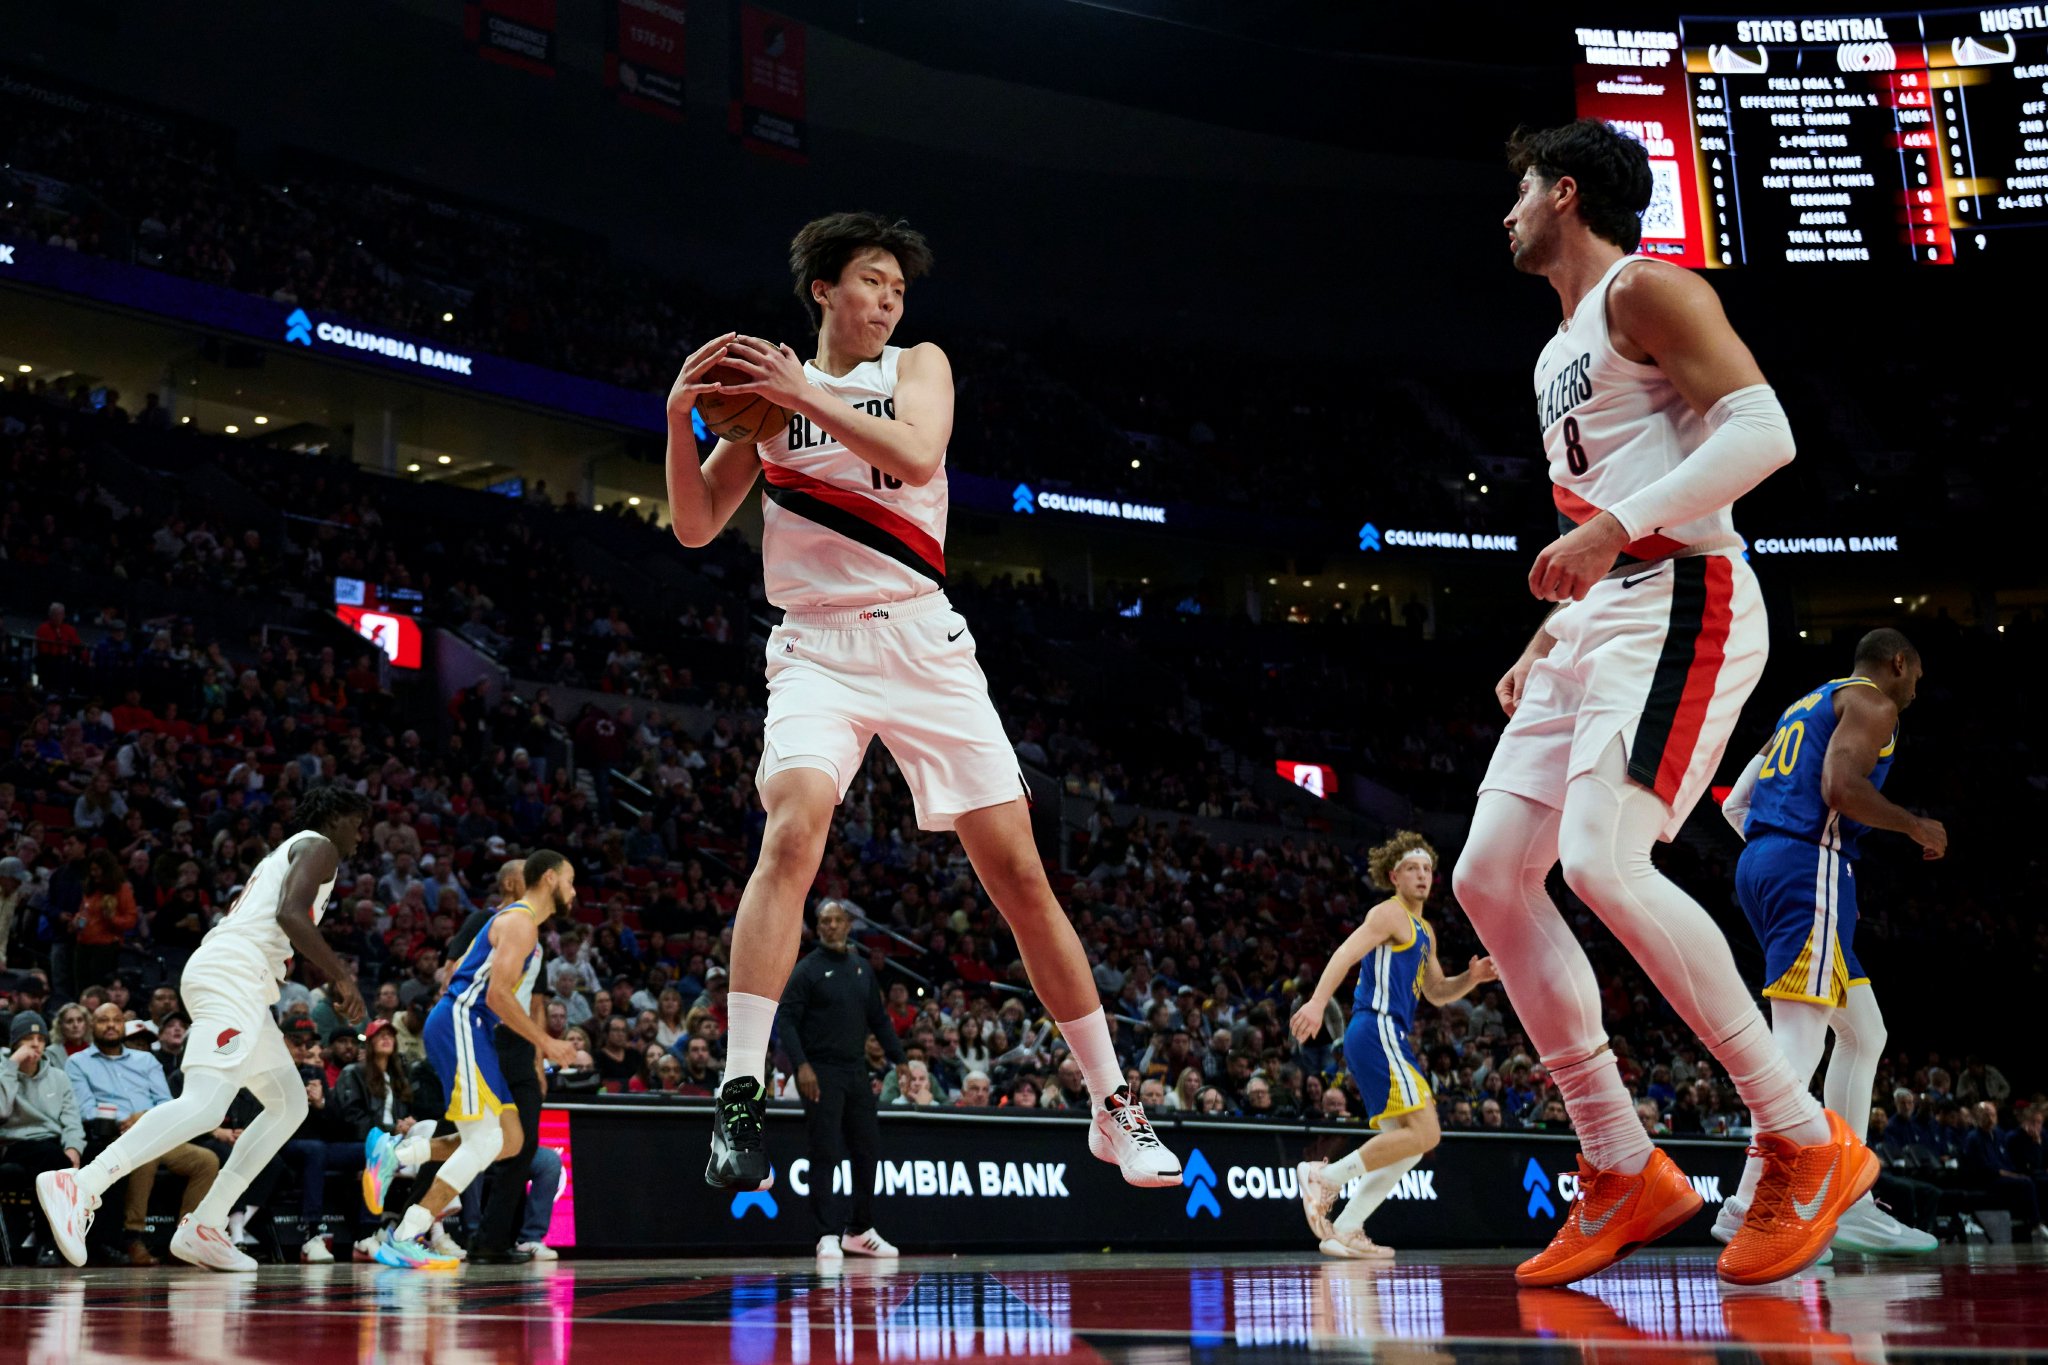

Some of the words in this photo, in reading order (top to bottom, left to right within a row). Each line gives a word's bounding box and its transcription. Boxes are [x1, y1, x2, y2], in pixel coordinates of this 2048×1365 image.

[1737, 20, 1797, 42] STATS
[1801, 18, 1888, 41] CENTRAL
[1575, 28, 1617, 47] TRAIL
[1617, 30, 1678, 49] BLAZERS
[1642, 49, 1670, 67] APP
[1768, 78, 1800, 90] FIELD
[1802, 78, 1833, 90] GOAL
[1740, 96, 1799, 108] EFFECTIVE
[1801, 95, 1833, 108] FIELD
[1835, 94, 1865, 107] GOAL
[2023, 101, 2046, 114] OFF
[1697, 114, 1727, 126] 100%
[1771, 114, 1801, 126] FREE
[1802, 113, 1850, 126] THROWS
[1898, 110, 1930, 123] 100%
[1644, 121, 1664, 140] TO
[2019, 120, 2044, 133] 2ND
[1780, 135, 1847, 148] 3-POINTERS
[1770, 157, 1812, 169] POINTS
[1814, 156, 1826, 168] IN
[1828, 156, 1862, 169] PAINT
[2015, 157, 2048, 171] FORC
[1763, 176, 1790, 188] FAST
[1791, 175, 1831, 188] BREAK
[1832, 174, 1874, 187] POINTS
[1790, 193, 1851, 206] REBOUNDS
[1917, 190, 1932, 203] 10
[1998, 194, 2042, 209] 24-SEC
[1800, 212, 1847, 224] ASSISTS
[1788, 231, 1823, 243] TOTAL
[1825, 230, 1862, 242] FOULS
[1786, 249, 1825, 262] BENCH
[1827, 248, 1869, 261] POINTS
[316, 322, 417, 362] COLUMBIA
[420, 347, 472, 375] BANK
[1563, 416, 1589, 476] 8
[1037, 492, 1120, 517] COLUMBIA
[1122, 503, 1165, 523] BANK
[1384, 529, 1469, 548] COLUMBIA
[1471, 534, 1517, 551] BANK
[1754, 537, 1846, 554] COLUMBIA
[1848, 536, 1898, 551] BANK
[859, 609, 889, 621] ripcity
[1759, 720, 1804, 779] 20
[979, 1161, 1070, 1197] BANK
[1386, 1169, 1438, 1200] ANK
